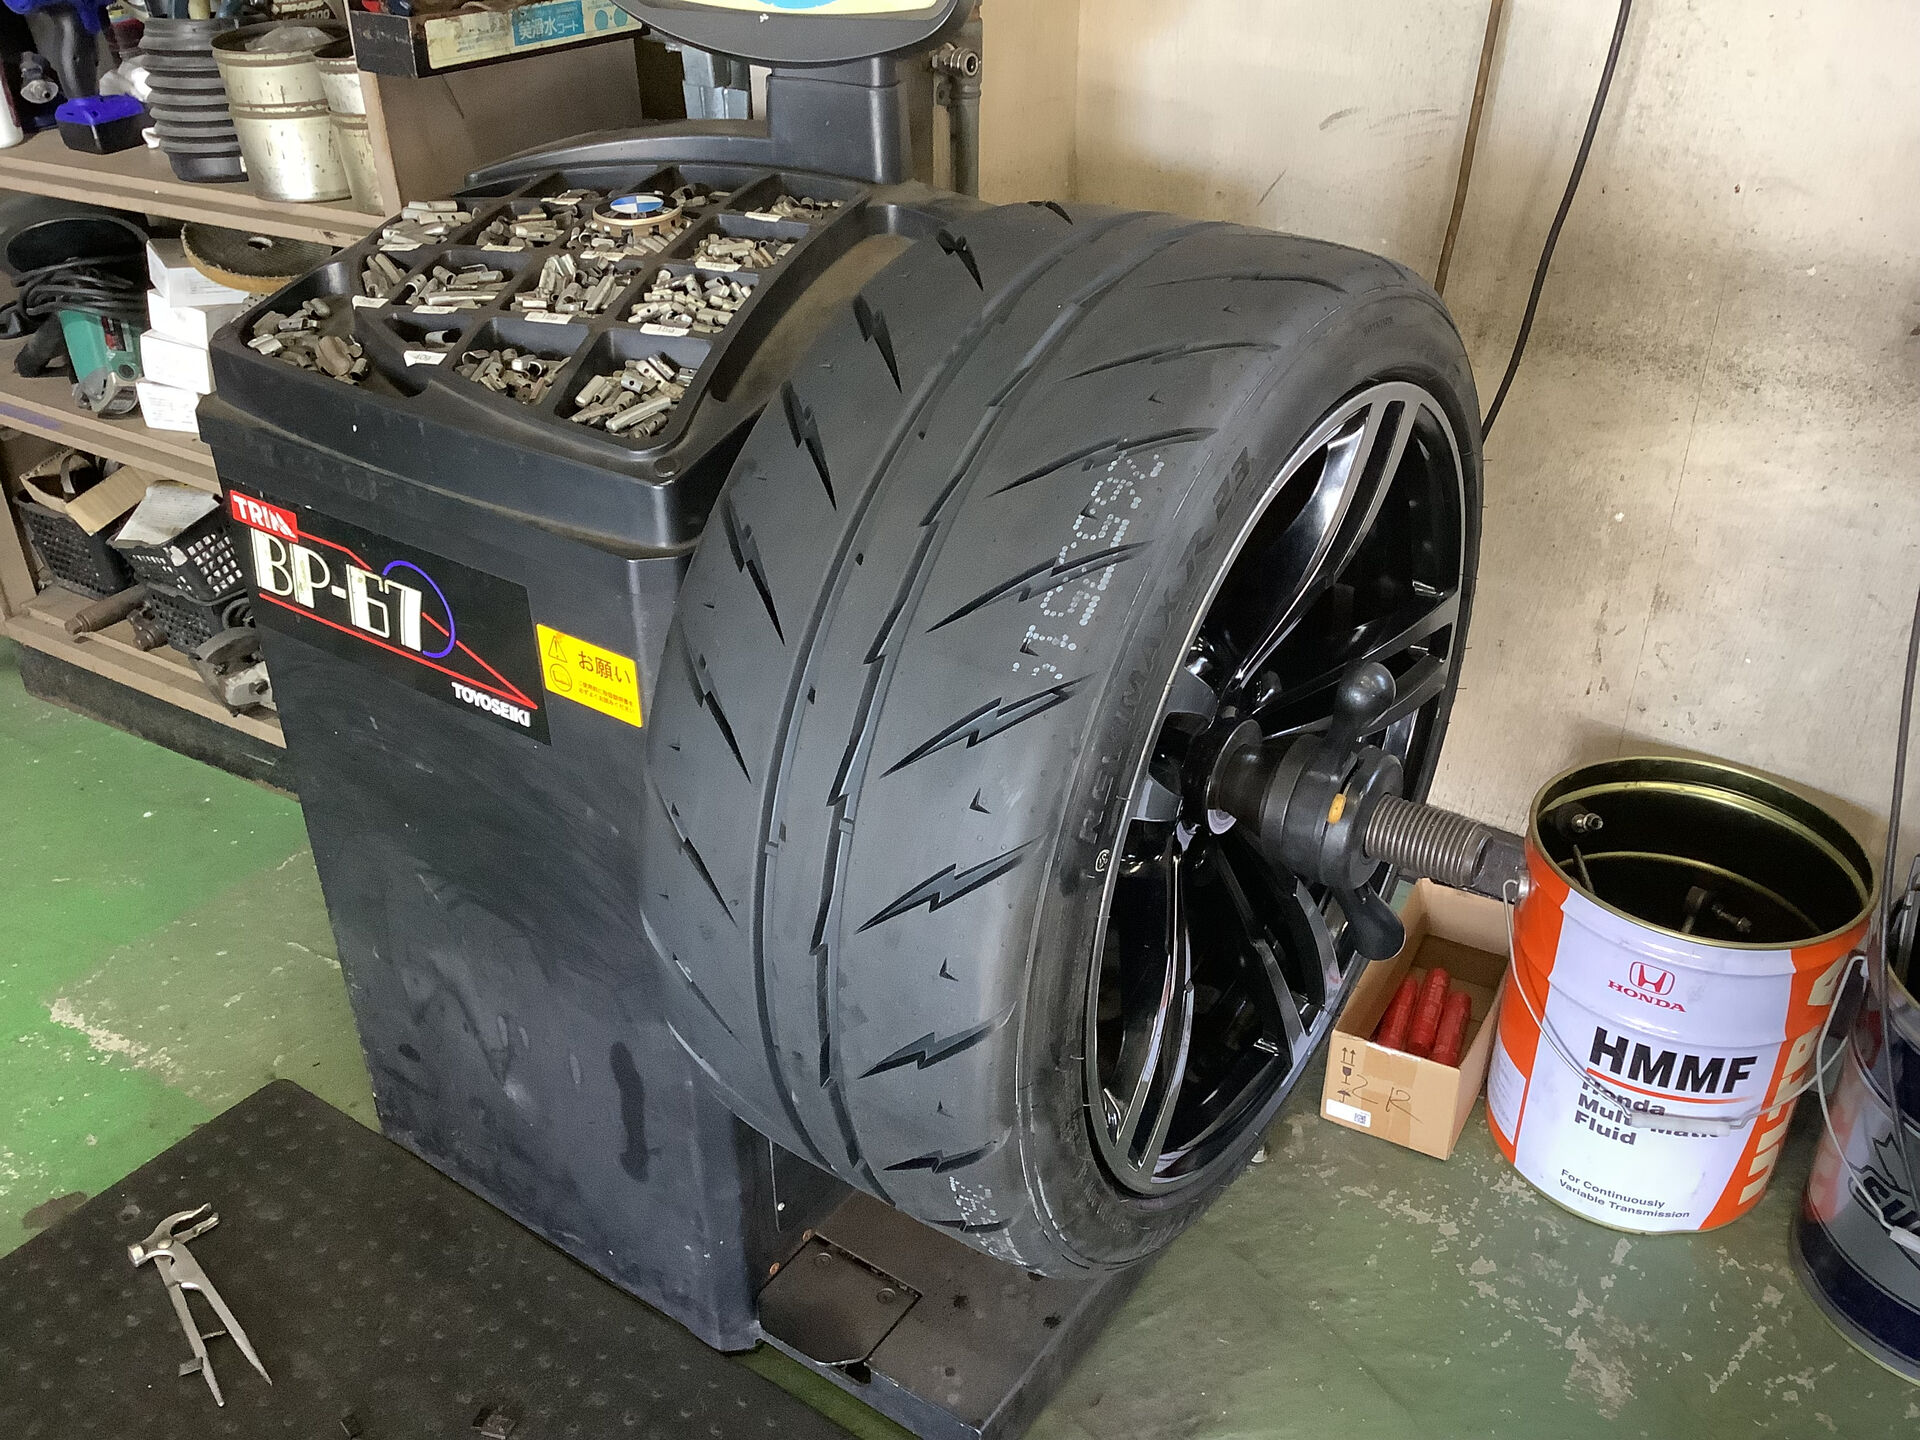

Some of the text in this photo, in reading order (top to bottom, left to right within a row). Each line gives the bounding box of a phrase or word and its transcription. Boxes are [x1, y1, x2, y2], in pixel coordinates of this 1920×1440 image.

[578, 650, 632, 685] お願い
[451, 681, 531, 728] TOYOSEIKI
[1608, 979, 1687, 1013] HONDA
[1589, 1025, 1759, 1094] HMMF
[1574, 1109, 1637, 1146] Fluid
[1559, 1178, 1690, 1219] Variable Transmission
[1561, 1168, 1666, 1209] For Continuously
